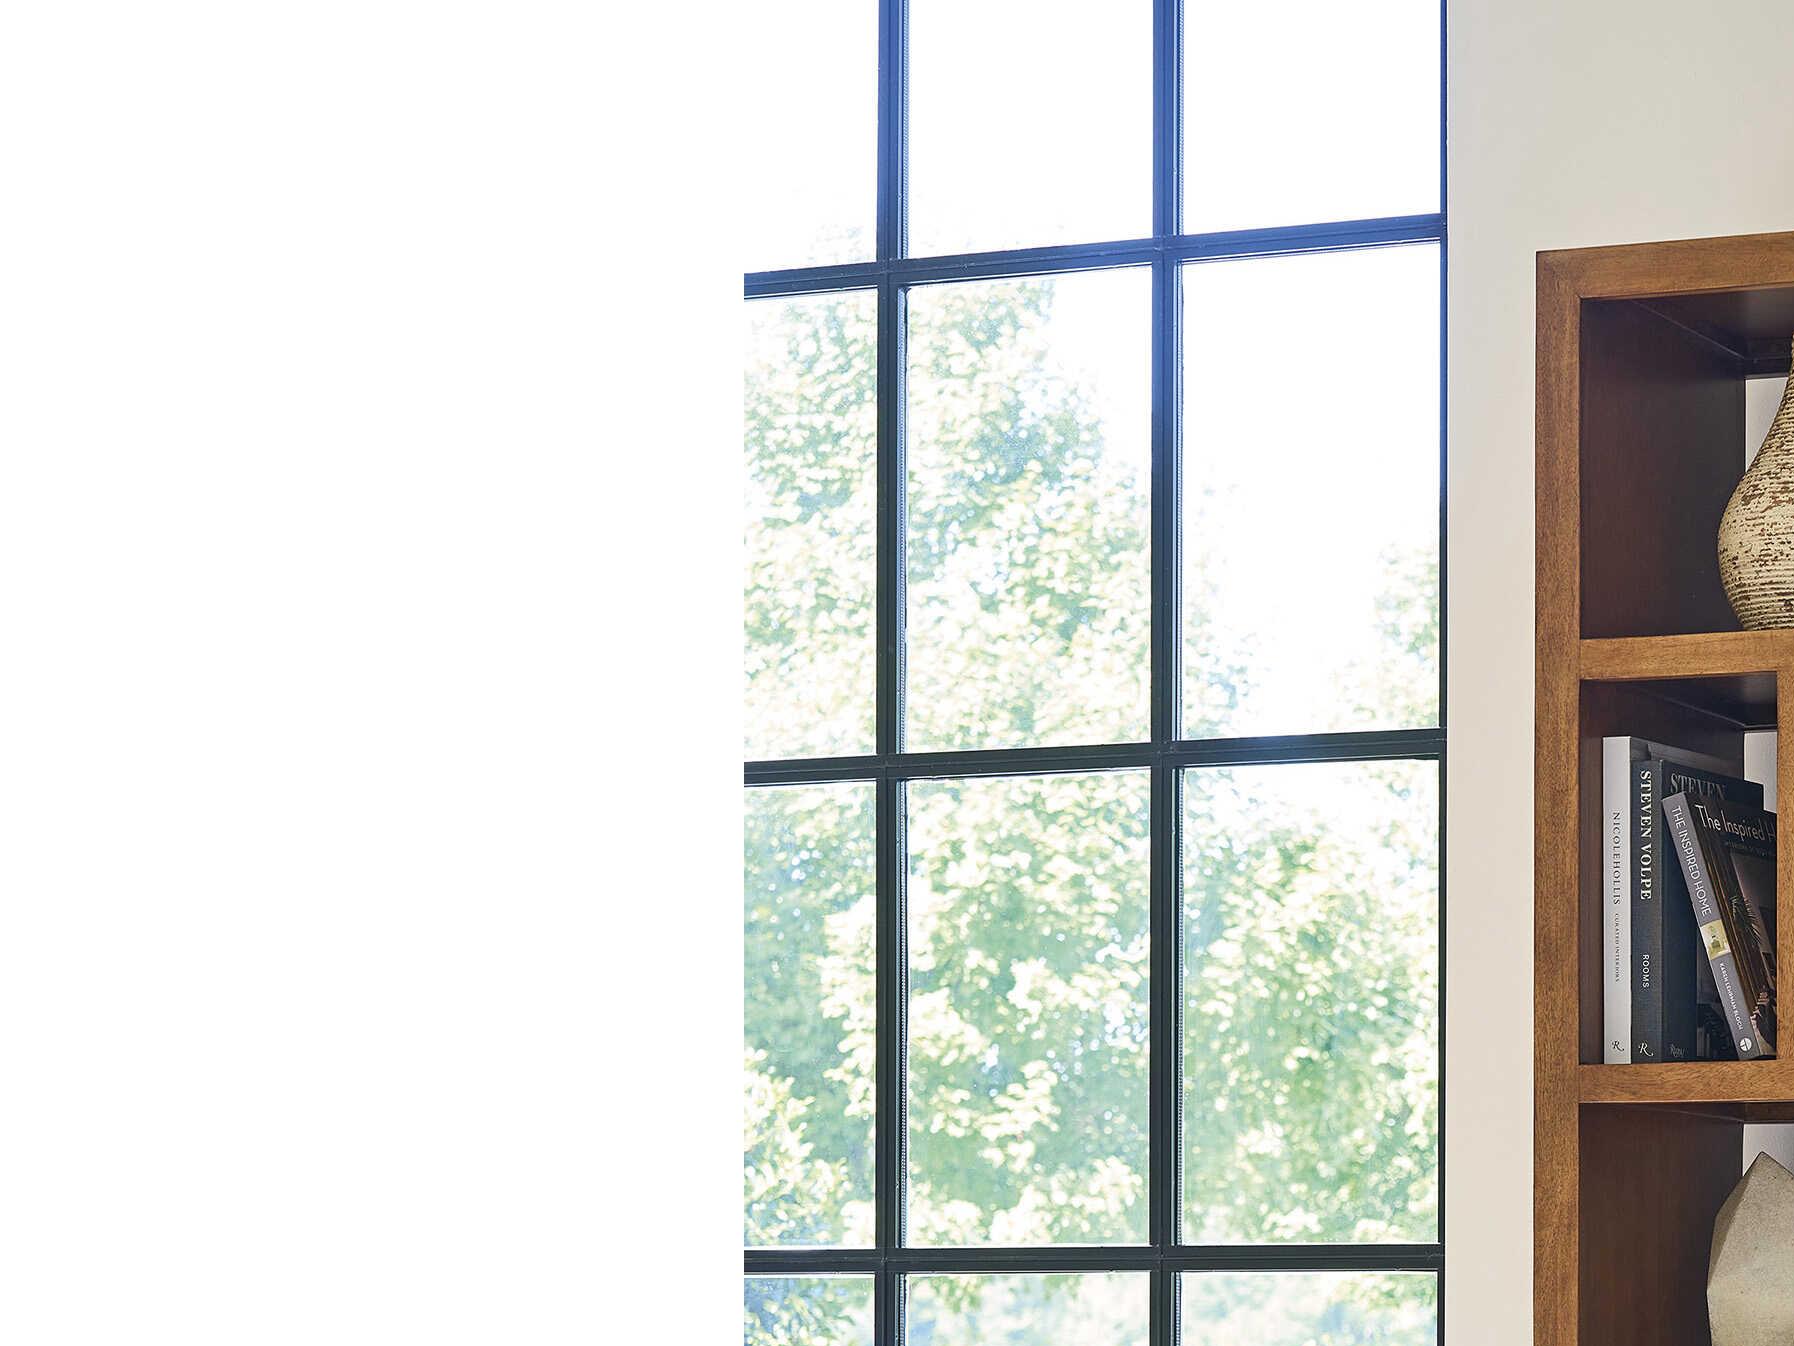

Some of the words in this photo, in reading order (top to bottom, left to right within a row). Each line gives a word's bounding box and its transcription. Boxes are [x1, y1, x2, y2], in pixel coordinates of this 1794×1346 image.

[1640, 770, 1652, 838] STEVEN
[1670, 773, 1727, 801] STEVEN
[1671, 805, 1687, 829] THE
[1694, 803, 1721, 831] The
[1721, 810, 1765, 842] Inspired
[1640, 843, 1652, 900] VOLPE
[1678, 829, 1701, 880] INSPIRED
[1694, 880, 1712, 917] HOME
[1642, 954, 1650, 988] ROOMS
